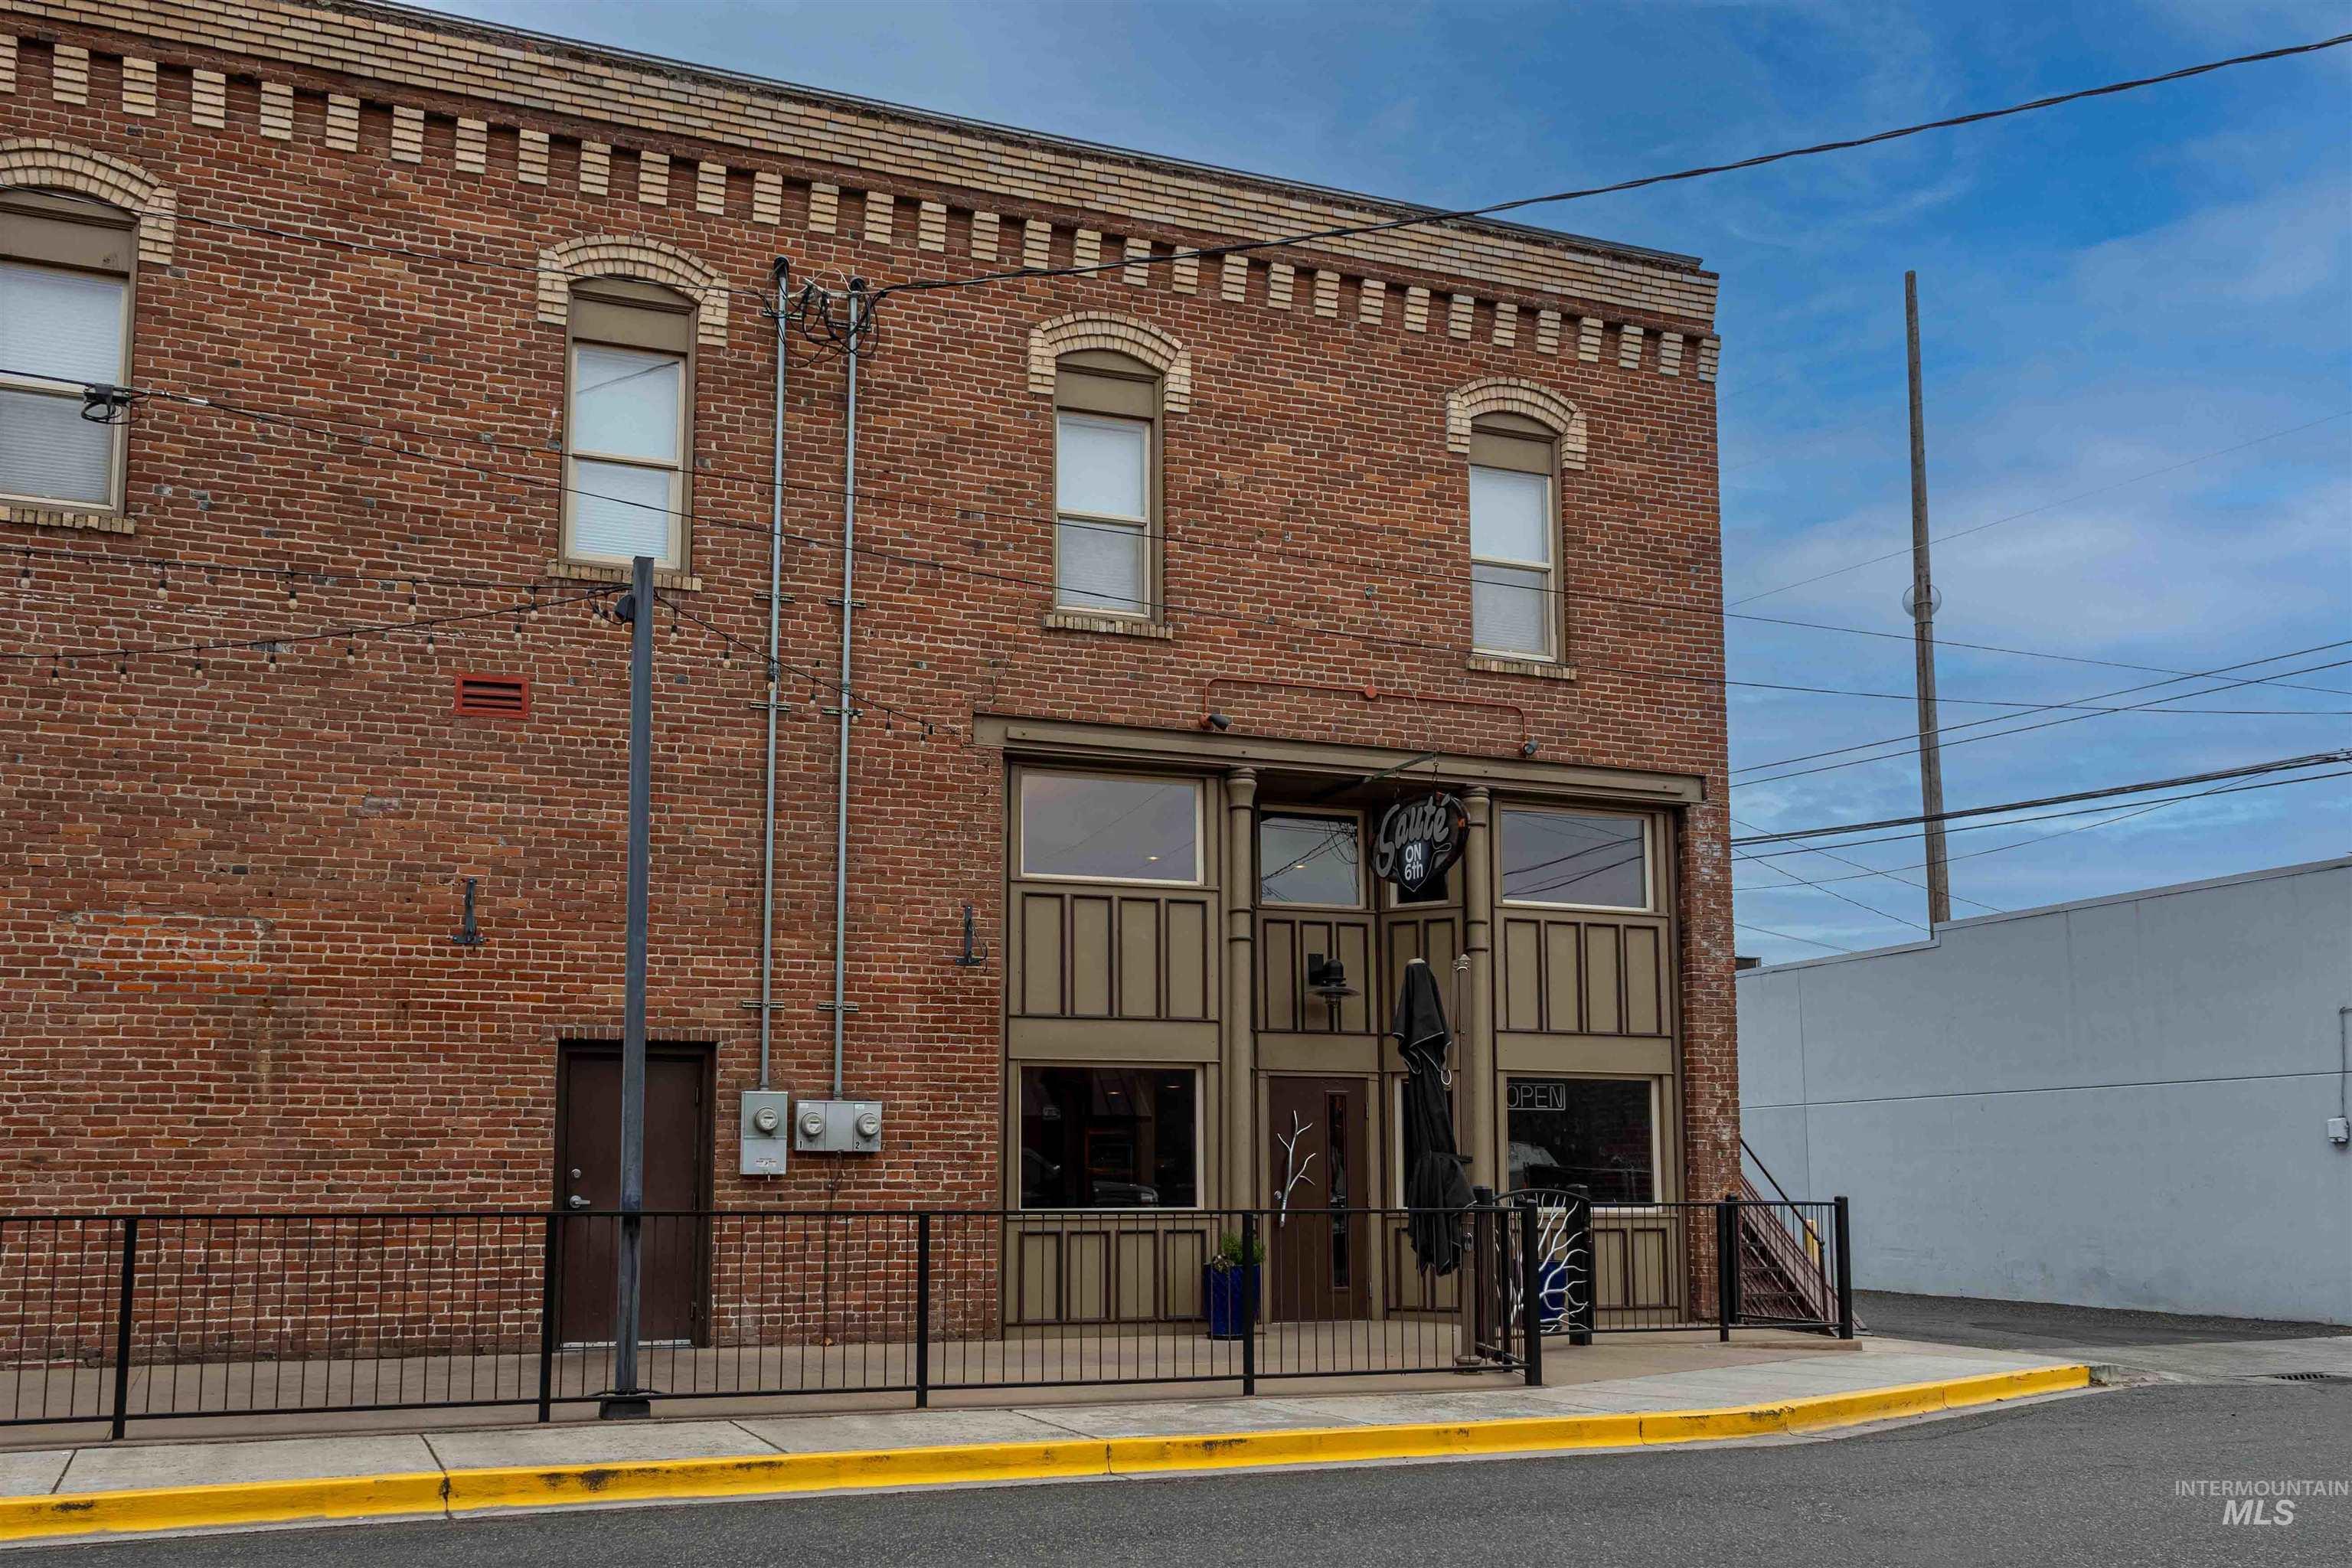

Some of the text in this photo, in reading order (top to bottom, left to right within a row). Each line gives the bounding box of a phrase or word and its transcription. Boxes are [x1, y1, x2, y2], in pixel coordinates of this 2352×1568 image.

[1376, 792, 1449, 877] Sauté
[1405, 843, 1422, 863] ON
[1404, 862, 1423, 880] 6th
[1507, 1085, 1563, 1108] OPEN
